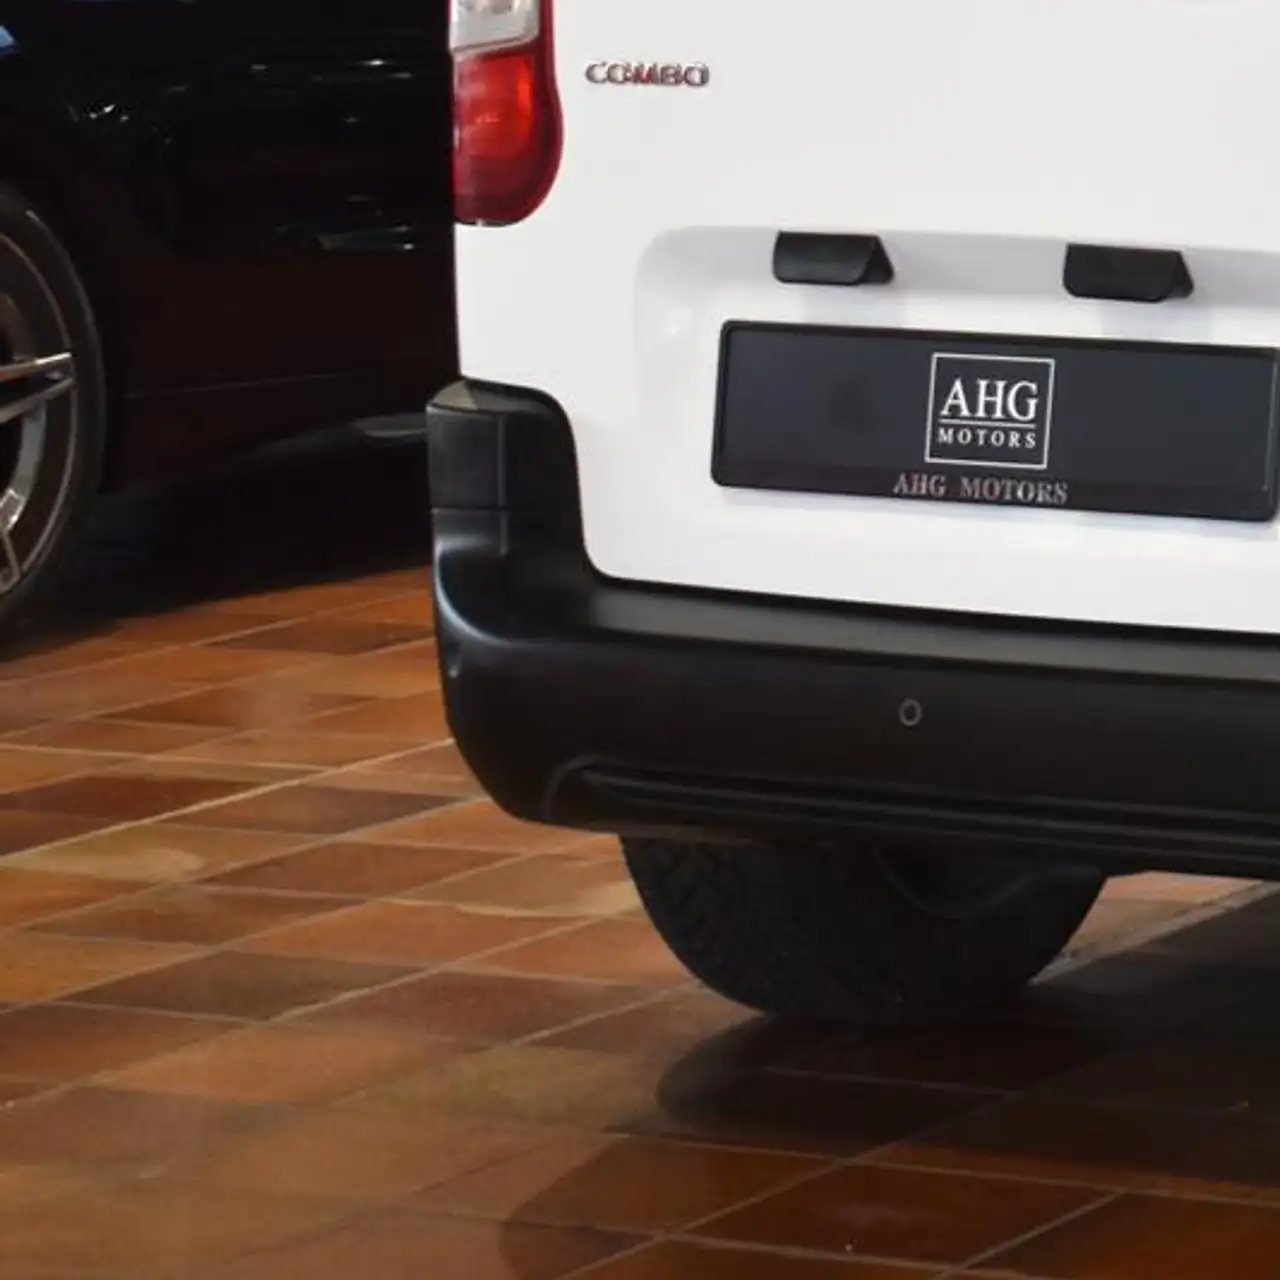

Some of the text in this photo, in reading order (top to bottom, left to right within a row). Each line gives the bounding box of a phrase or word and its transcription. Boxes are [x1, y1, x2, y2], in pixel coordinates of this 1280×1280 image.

[585, 62, 710, 87] COMBO
[939, 377, 1039, 421] AHG
[937, 426, 1037, 449] MOTORS
[892, 471, 1069, 506] AHG MOTORS
